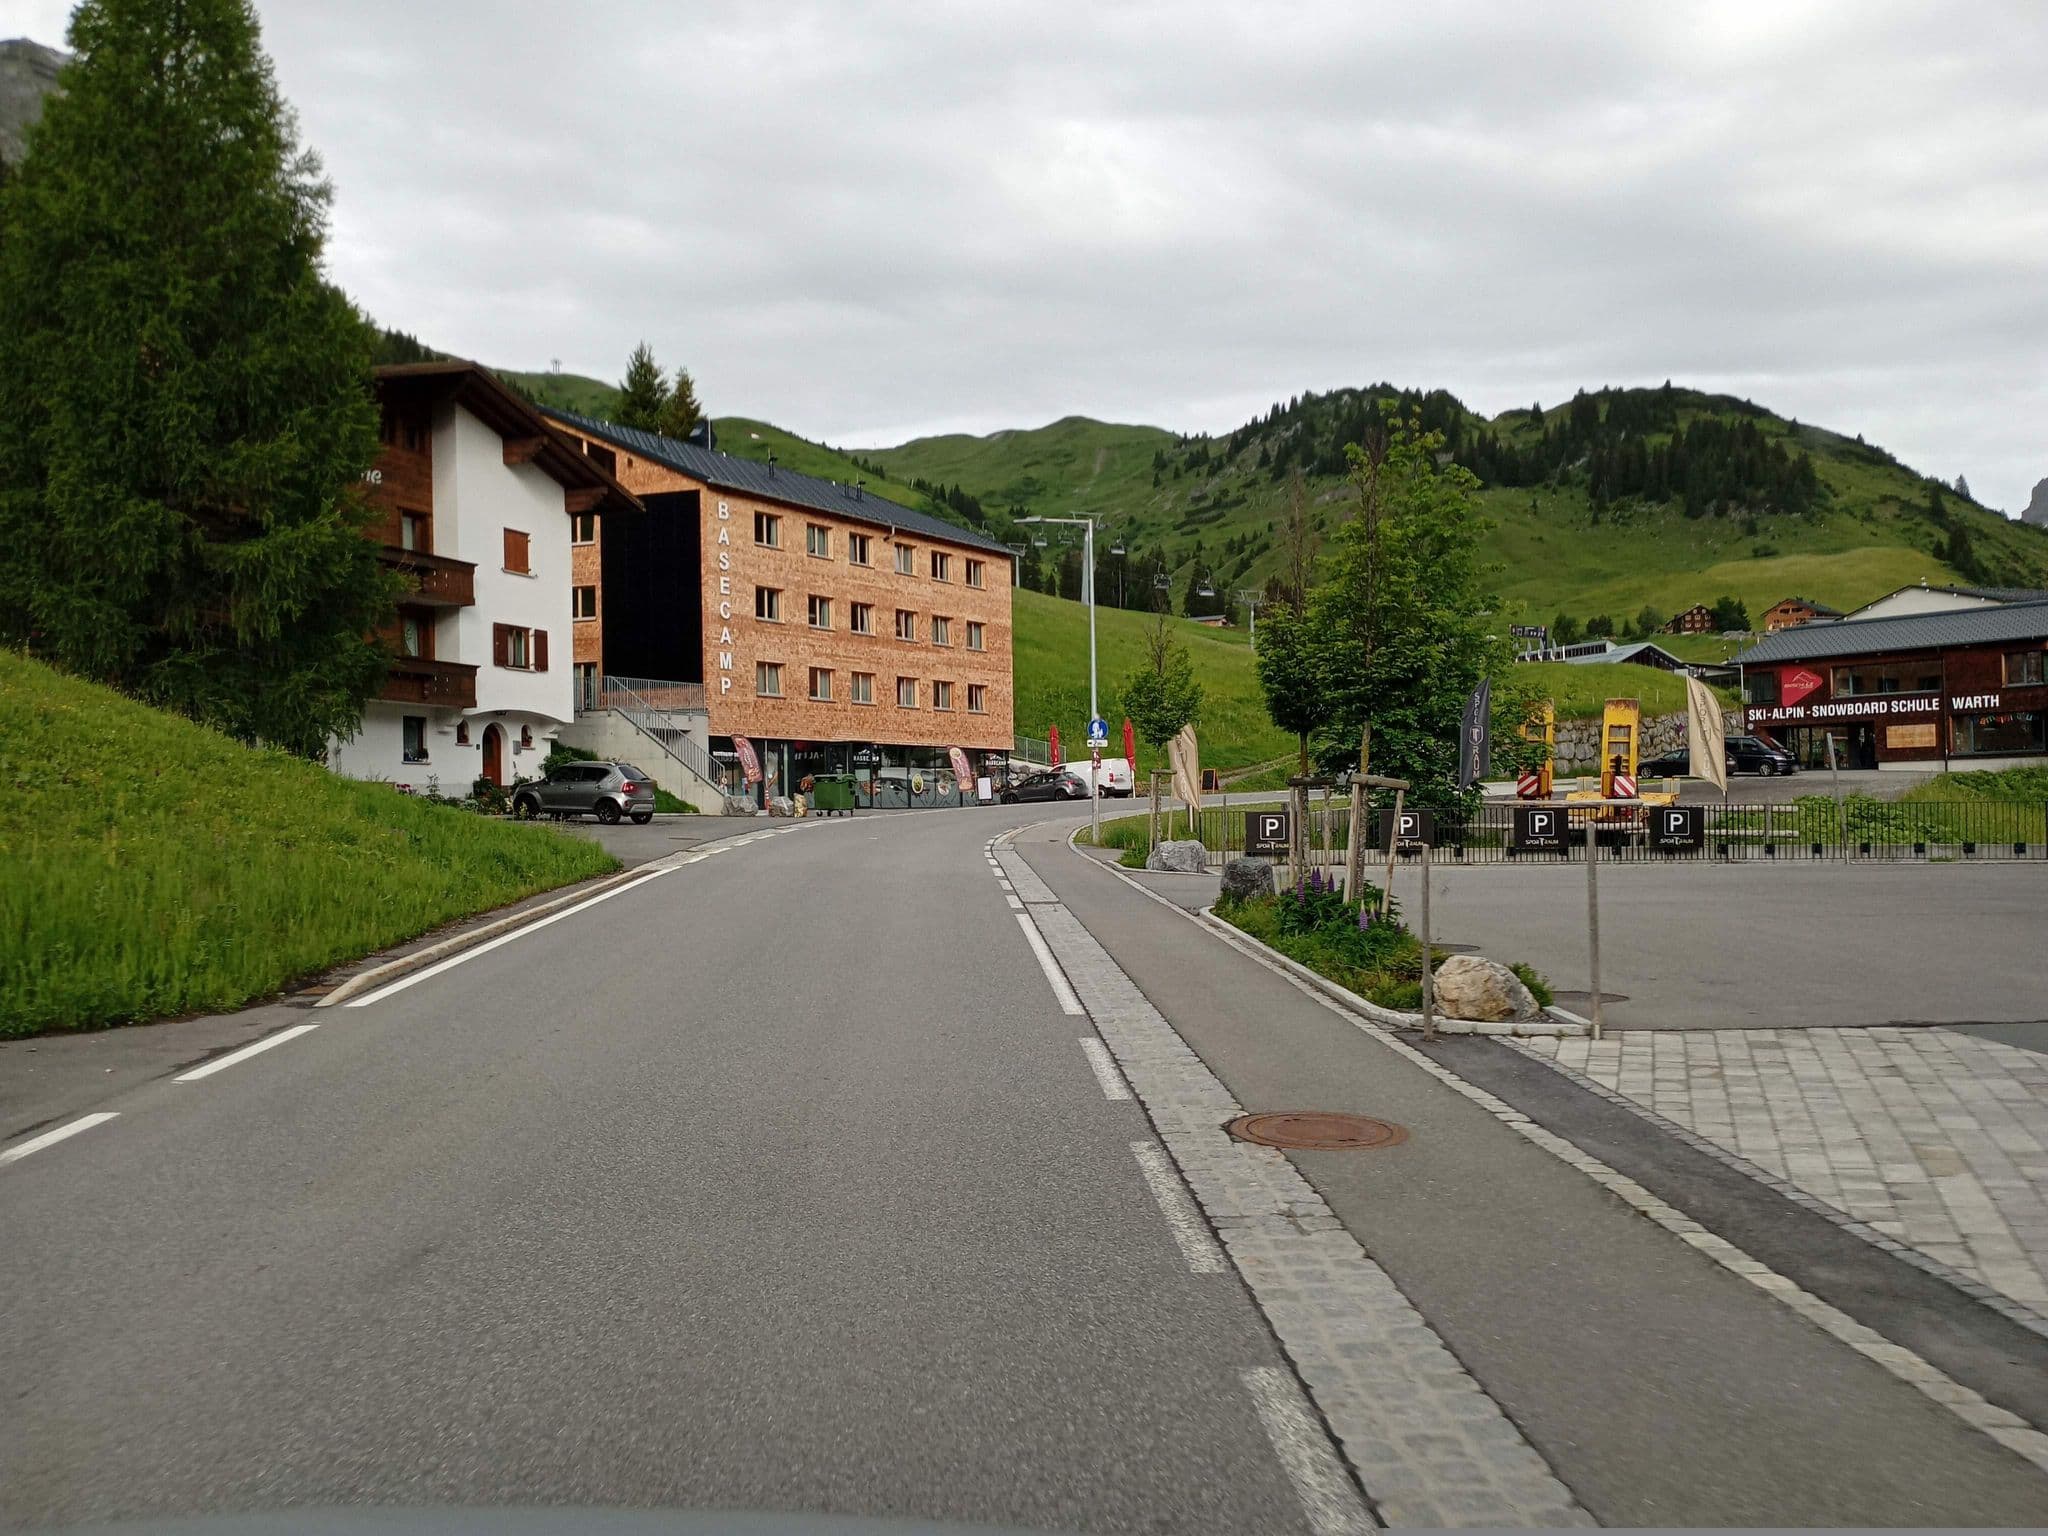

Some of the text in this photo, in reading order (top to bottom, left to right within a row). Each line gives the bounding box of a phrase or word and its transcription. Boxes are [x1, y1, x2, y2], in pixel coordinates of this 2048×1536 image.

[717, 501, 733, 695] BASECAMP
[1891, 697, 1940, 713] SCHULE
[1951, 694, 2000, 710] WARTH
[1265, 818, 1279, 837] P
[1400, 816, 1413, 835] P
[1534, 814, 1548, 833] P
[1669, 813, 1683, 832] P
